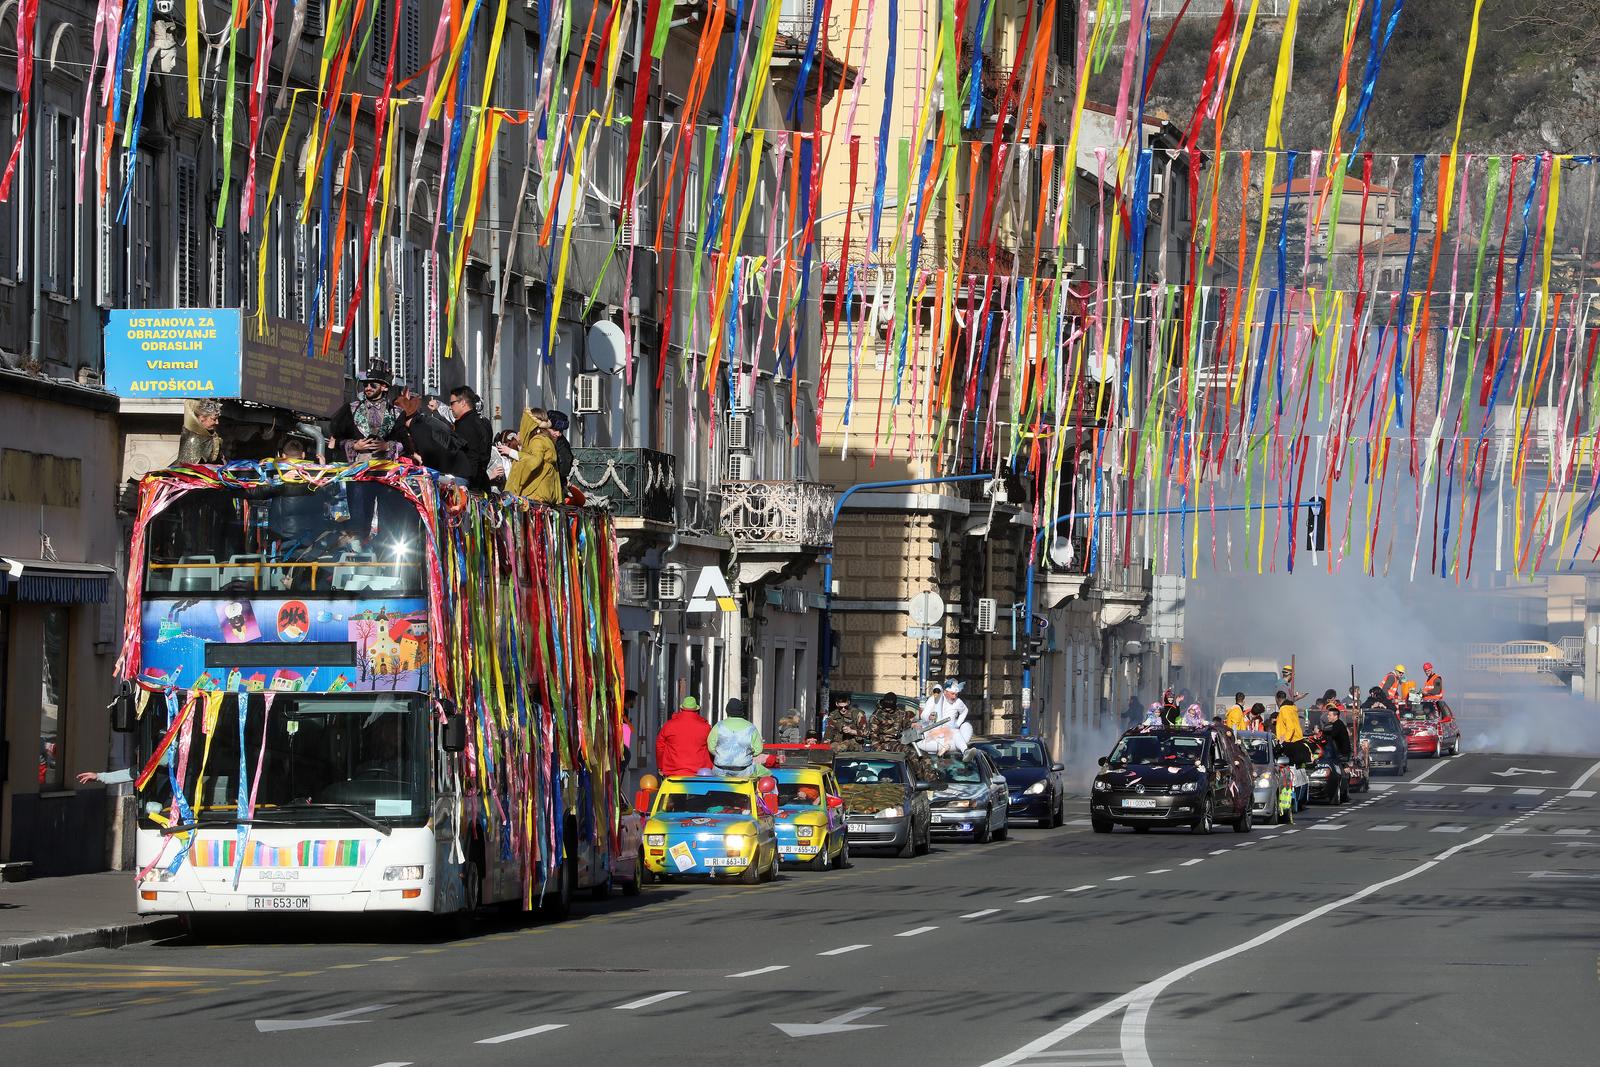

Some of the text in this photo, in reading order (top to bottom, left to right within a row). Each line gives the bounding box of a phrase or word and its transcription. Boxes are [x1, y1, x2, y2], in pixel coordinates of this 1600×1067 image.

[129, 317, 215, 328] USTANOVA ZA
[127, 329, 217, 339] OBRAZOVANJE
[141, 341, 203, 351] ODRASLIH
[130, 377, 215, 391] AUTOŠKOLA
[259, 870, 299, 880] MAN
[254, 897, 265, 909] RI
